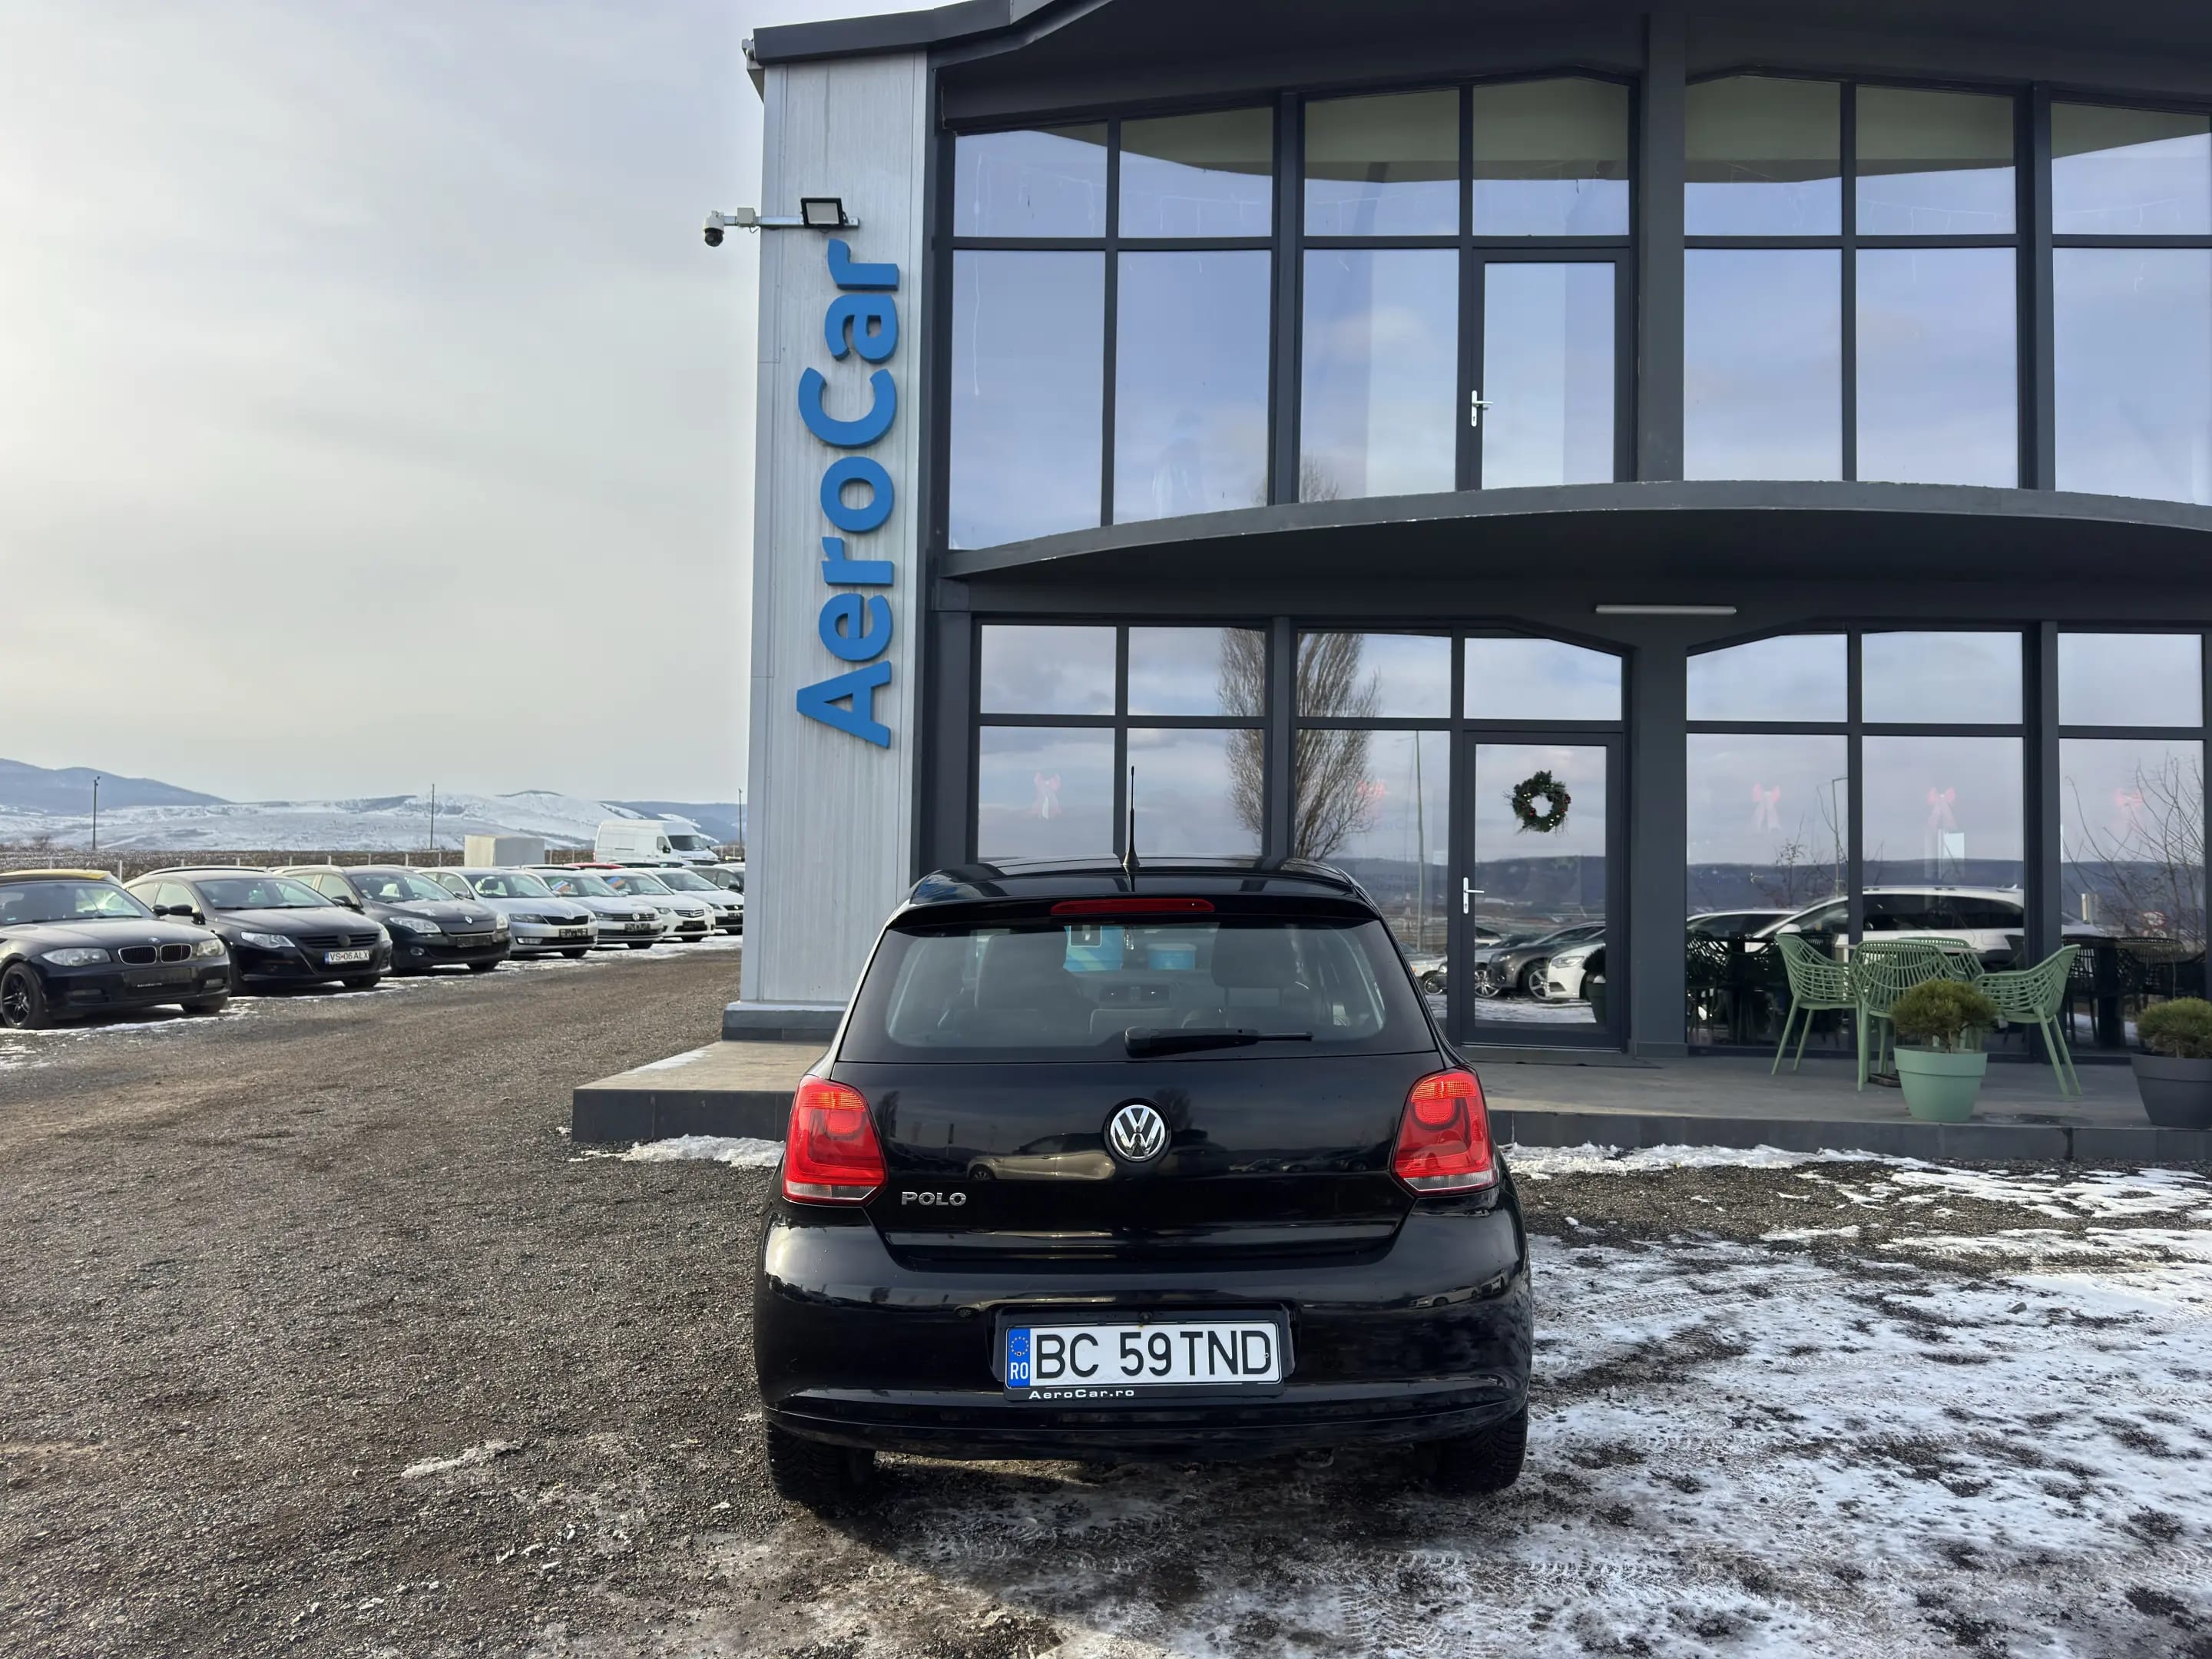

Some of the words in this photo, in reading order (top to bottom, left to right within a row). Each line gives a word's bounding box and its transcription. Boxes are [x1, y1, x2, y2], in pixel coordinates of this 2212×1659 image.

[796, 238, 899, 750] AeroCar
[901, 1191, 966, 1206] POLO
[1036, 1333, 1099, 1378] BC
[1010, 1362, 1028, 1379] RO
[1028, 1389, 1134, 1399] AeroCar.ro
